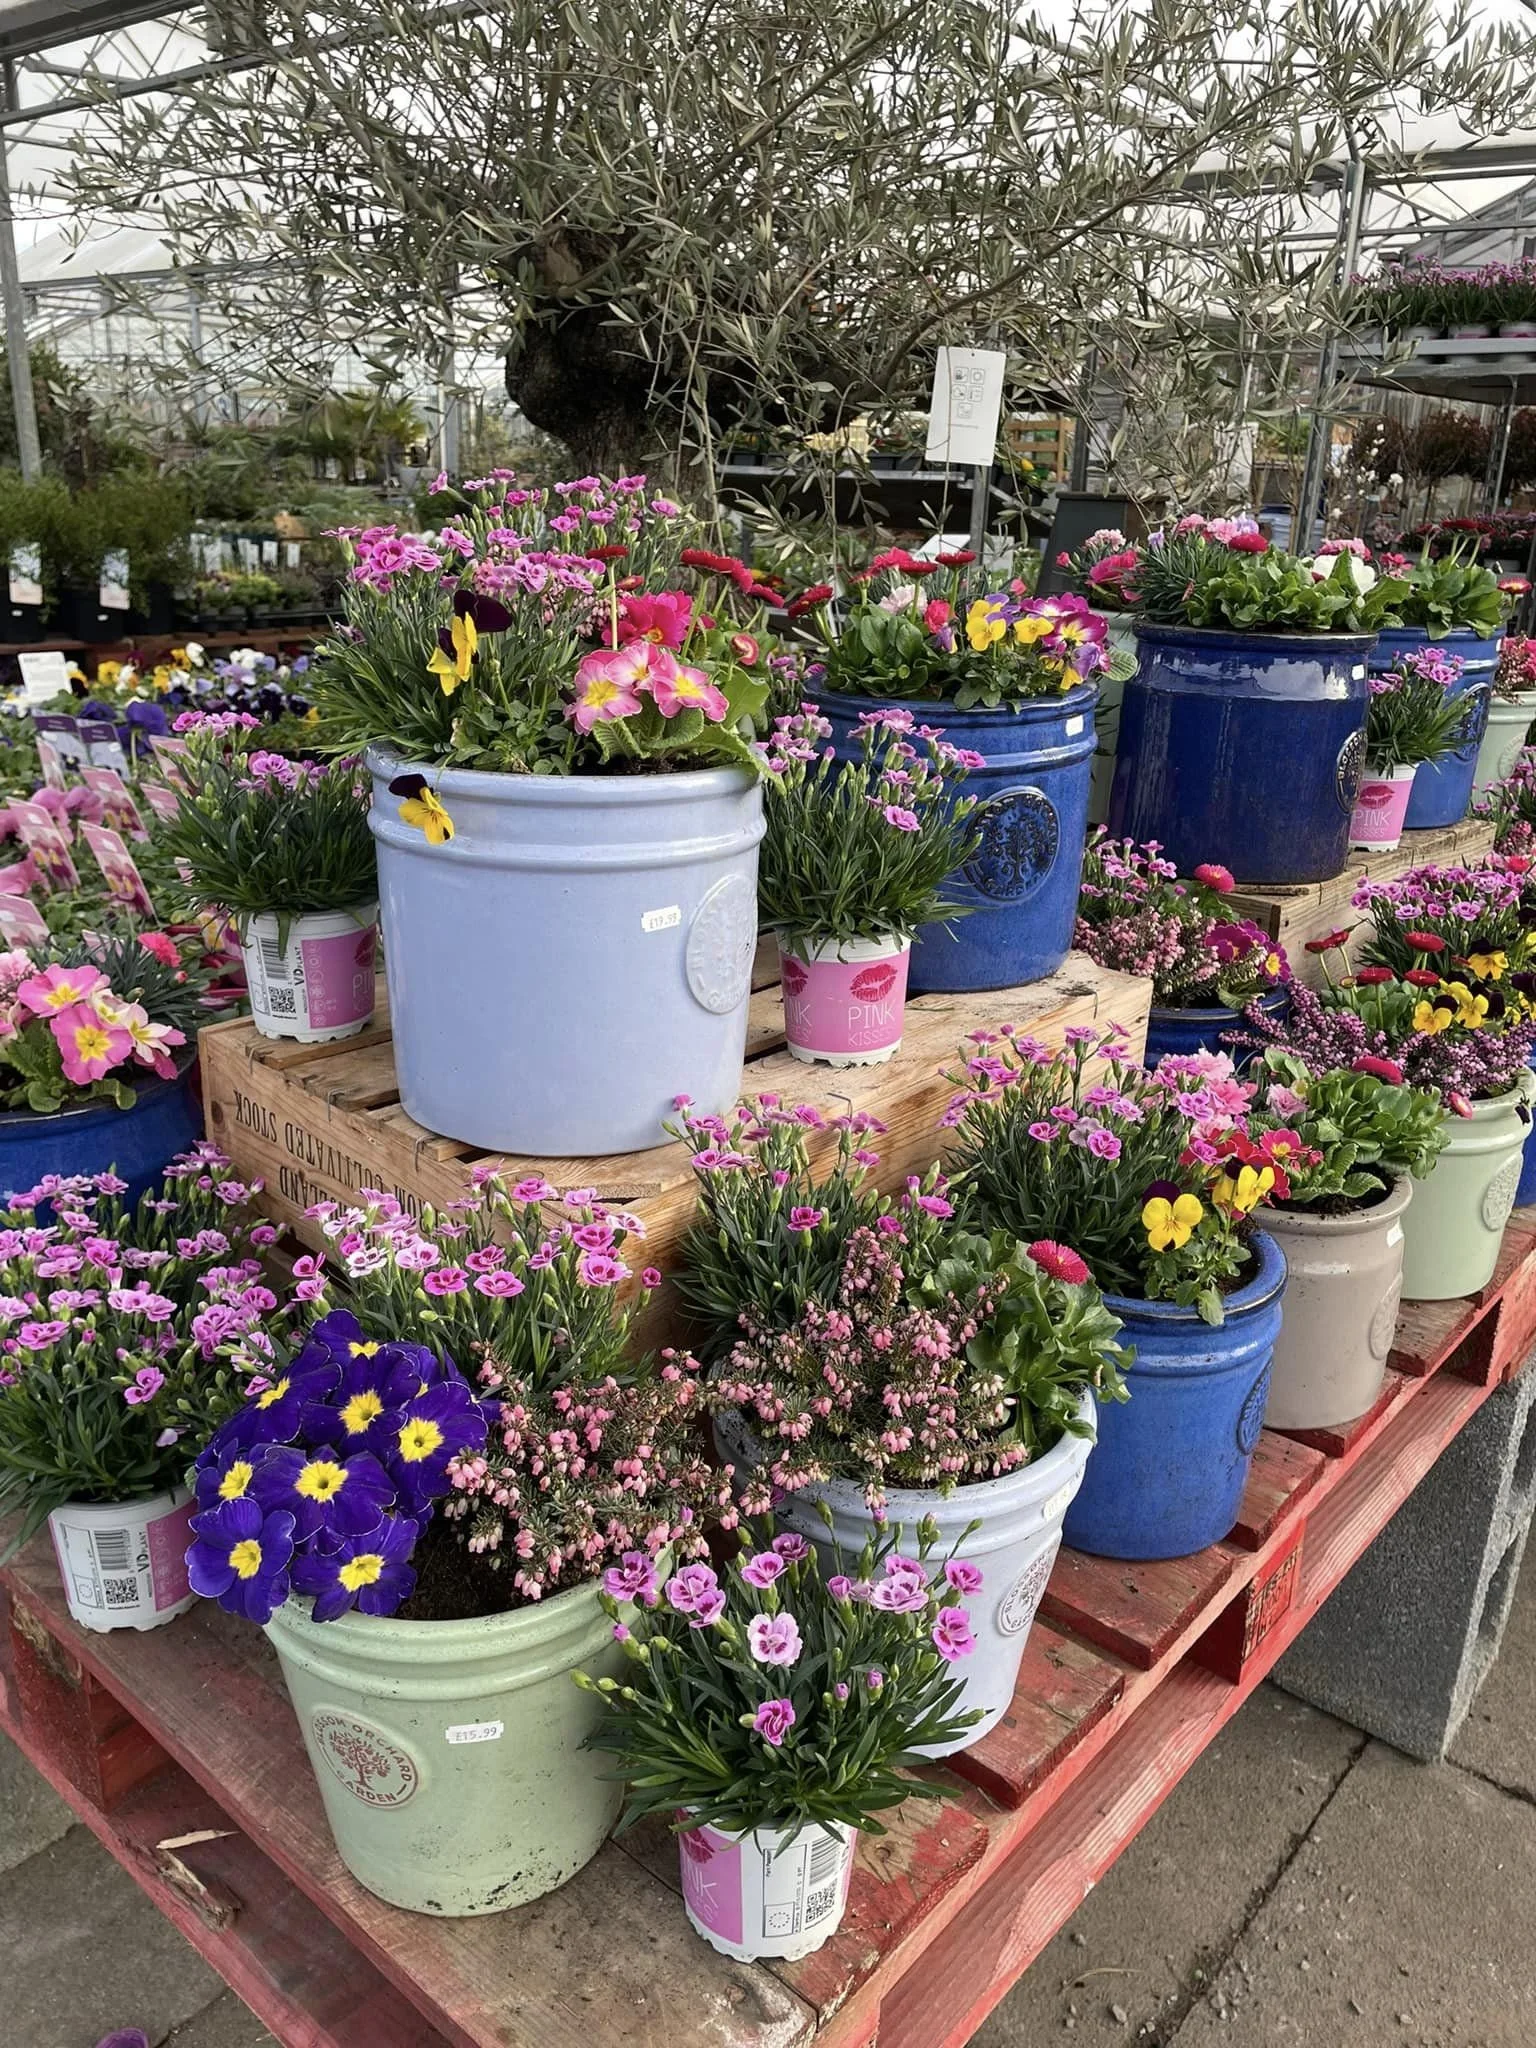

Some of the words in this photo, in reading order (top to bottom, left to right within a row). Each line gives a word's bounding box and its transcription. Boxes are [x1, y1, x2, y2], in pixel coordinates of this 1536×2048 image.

[1354, 809, 1393, 826] PINK
[848, 998, 897, 1030] PINK
[232, 1089, 278, 1143] STOCK
[284, 1122, 385, 1195] CULTIVATED
[351, 1724, 412, 1782] ORCHARD
[337, 1770, 397, 1803] GARDEN
